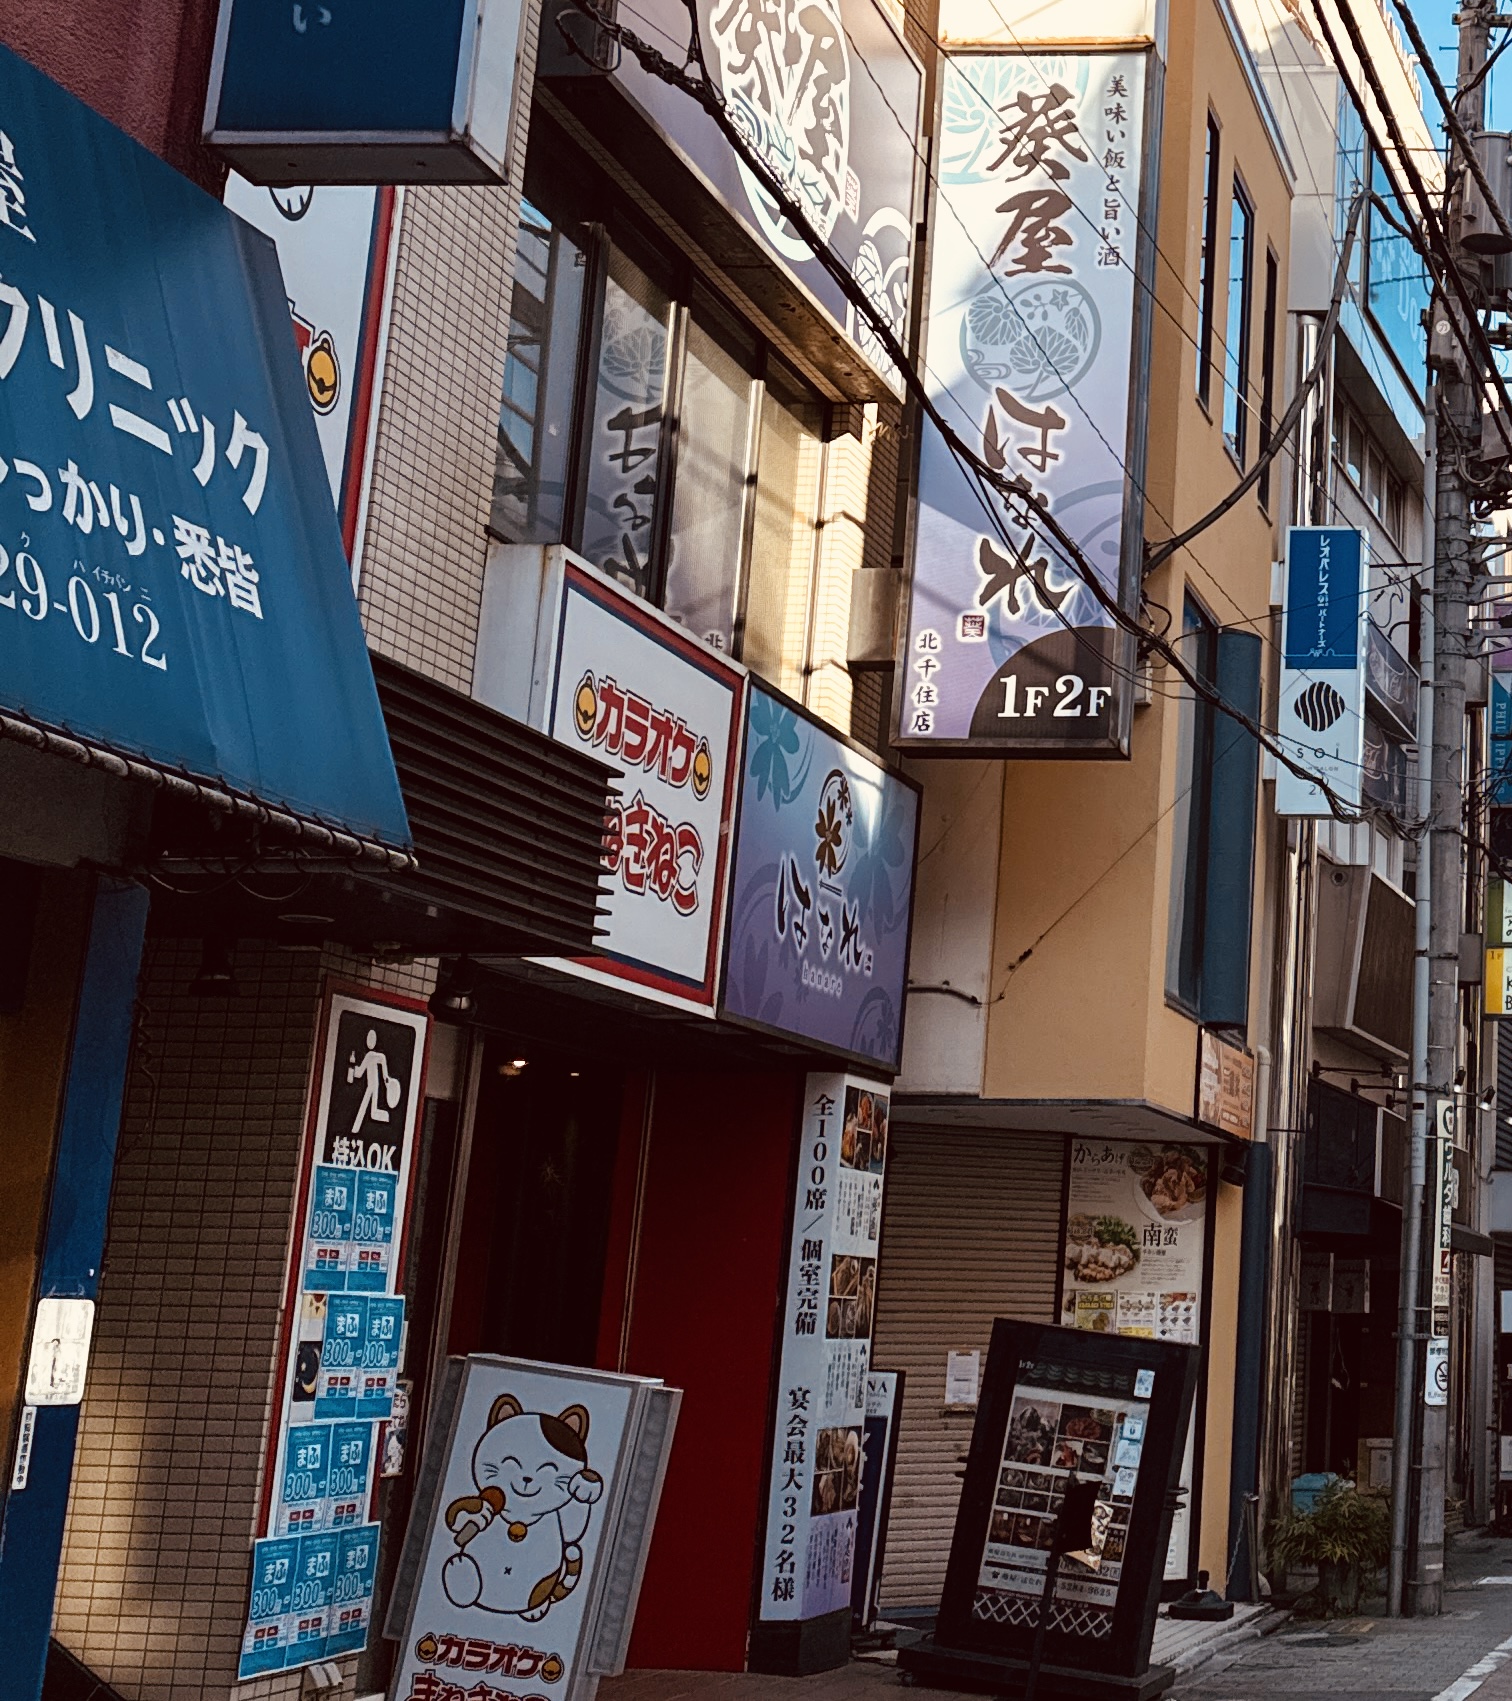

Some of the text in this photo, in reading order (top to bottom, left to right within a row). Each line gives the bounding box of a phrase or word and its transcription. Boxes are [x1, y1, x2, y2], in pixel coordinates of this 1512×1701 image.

[986, 83, 1089, 278] 葵屋
[1096, 75, 1128, 268] 美味い飯と旨い酒
[979, 388, 1073, 614] はなれ
[594, 677, 695, 787] カラオケ
[912, 632, 941, 732] 北千住店
[332, 1136, 397, 1172] 持込OK
[1073, 1143, 1126, 1167] からあげ
[1143, 1223, 1178, 1247] 南蛮
[771, 1386, 812, 1602] 宴会最大32名様
[436, 1635, 545, 1678] カラオケ
